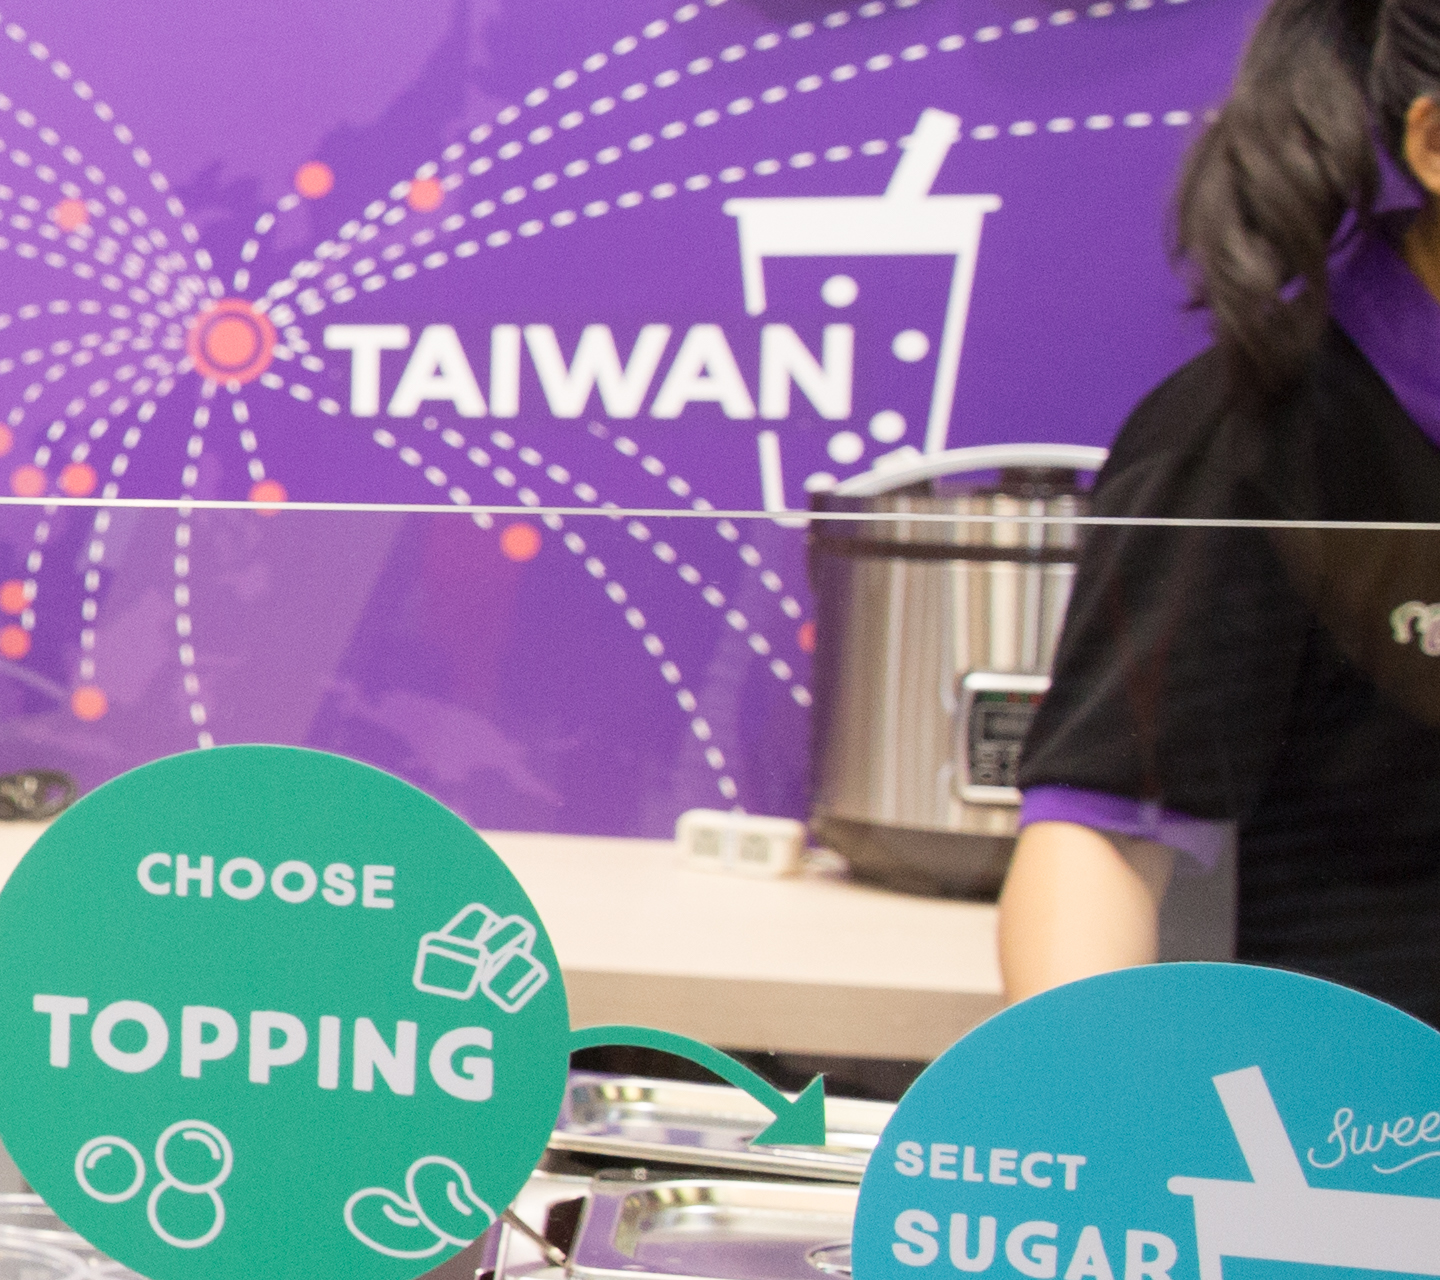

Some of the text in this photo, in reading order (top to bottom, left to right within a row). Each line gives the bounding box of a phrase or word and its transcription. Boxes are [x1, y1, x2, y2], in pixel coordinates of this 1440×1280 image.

[323, 324, 855, 419] TAIWAN
[137, 851, 397, 910] CHOOSE
[33, 993, 494, 1102] TOPPING
[894, 1141, 1087, 1191] SELECT
